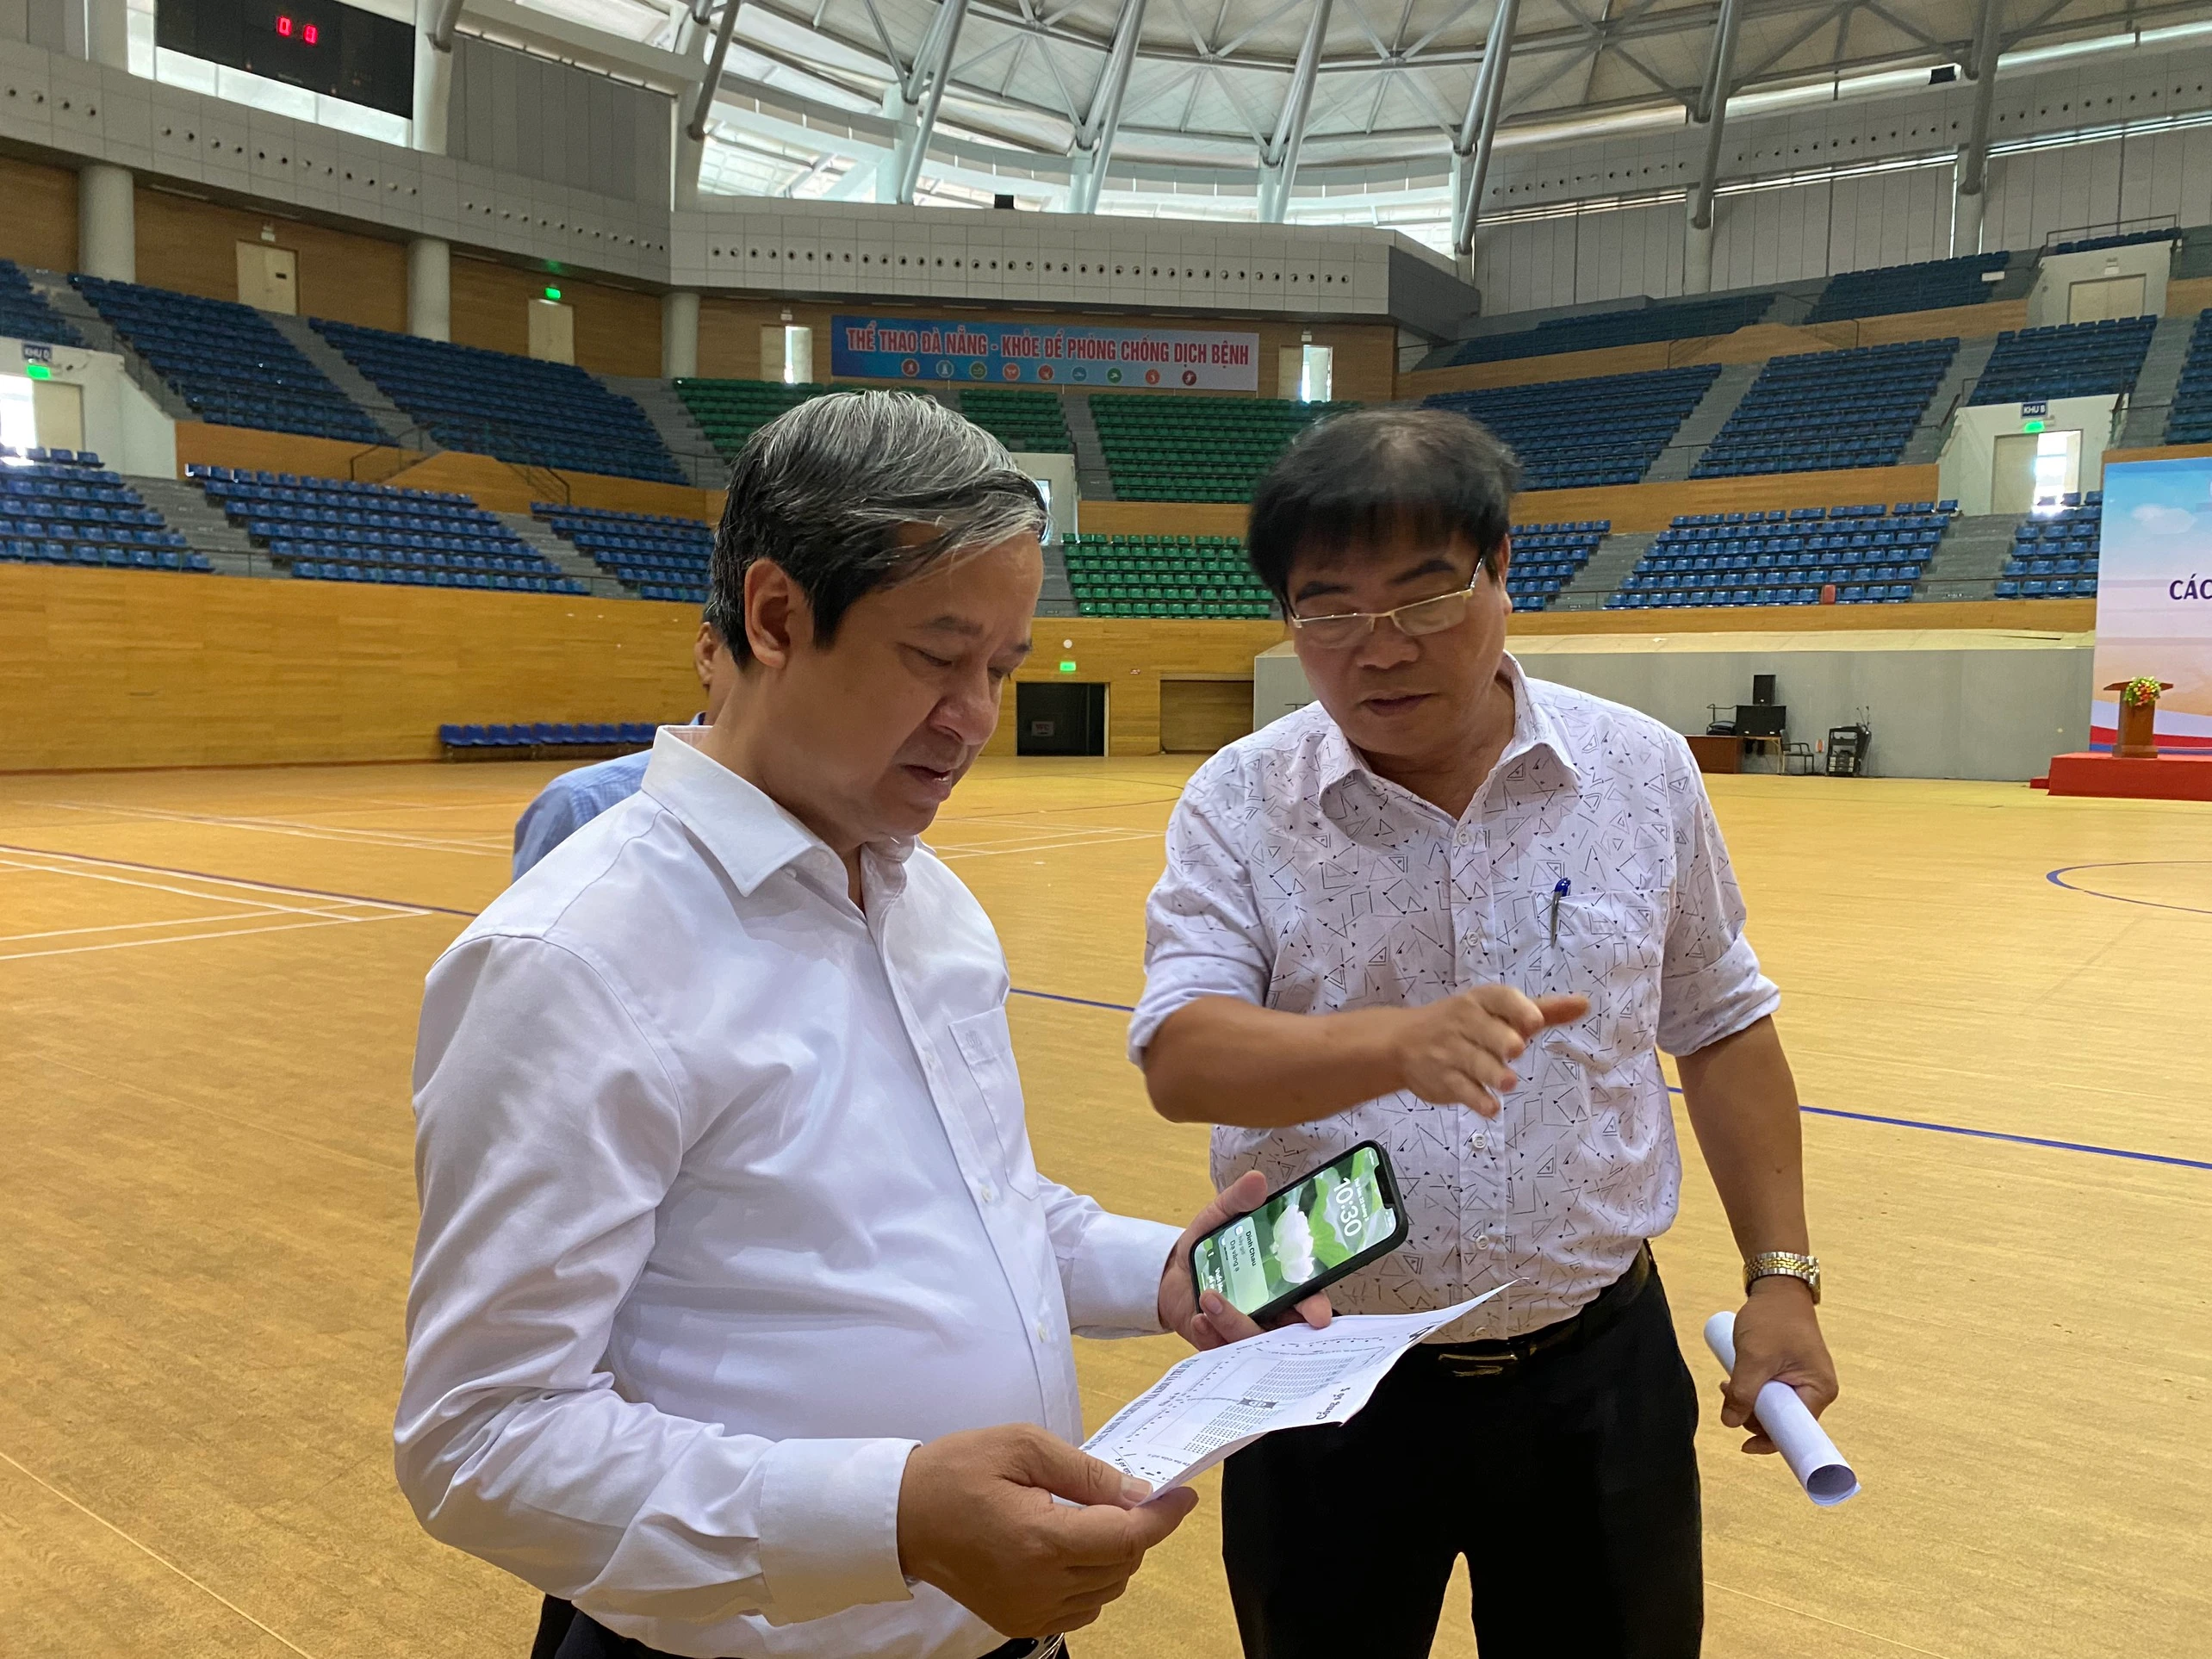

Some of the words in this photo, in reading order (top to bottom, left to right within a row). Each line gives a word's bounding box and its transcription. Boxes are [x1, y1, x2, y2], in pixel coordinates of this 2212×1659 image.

[847, 321, 876, 351] THỂ
[879, 329, 918, 352] THAO
[920, 327, 942, 354] ĐÀ
[946, 325, 988, 356] NẴNG
[1002, 329, 1041, 357] KHỎE
[1044, 329, 1064, 358] ĐỂ
[1067, 334, 1116, 360] PHÒNG
[1121, 335, 1169, 363] CHỐNG
[1174, 342, 1207, 368] DỊCH
[1211, 340, 1249, 369] BỆNH
[2024, 405, 2039, 413] KHU
[2169, 573, 2212, 600] CÁC
[1333, 1177, 1363, 1237] 10:30
